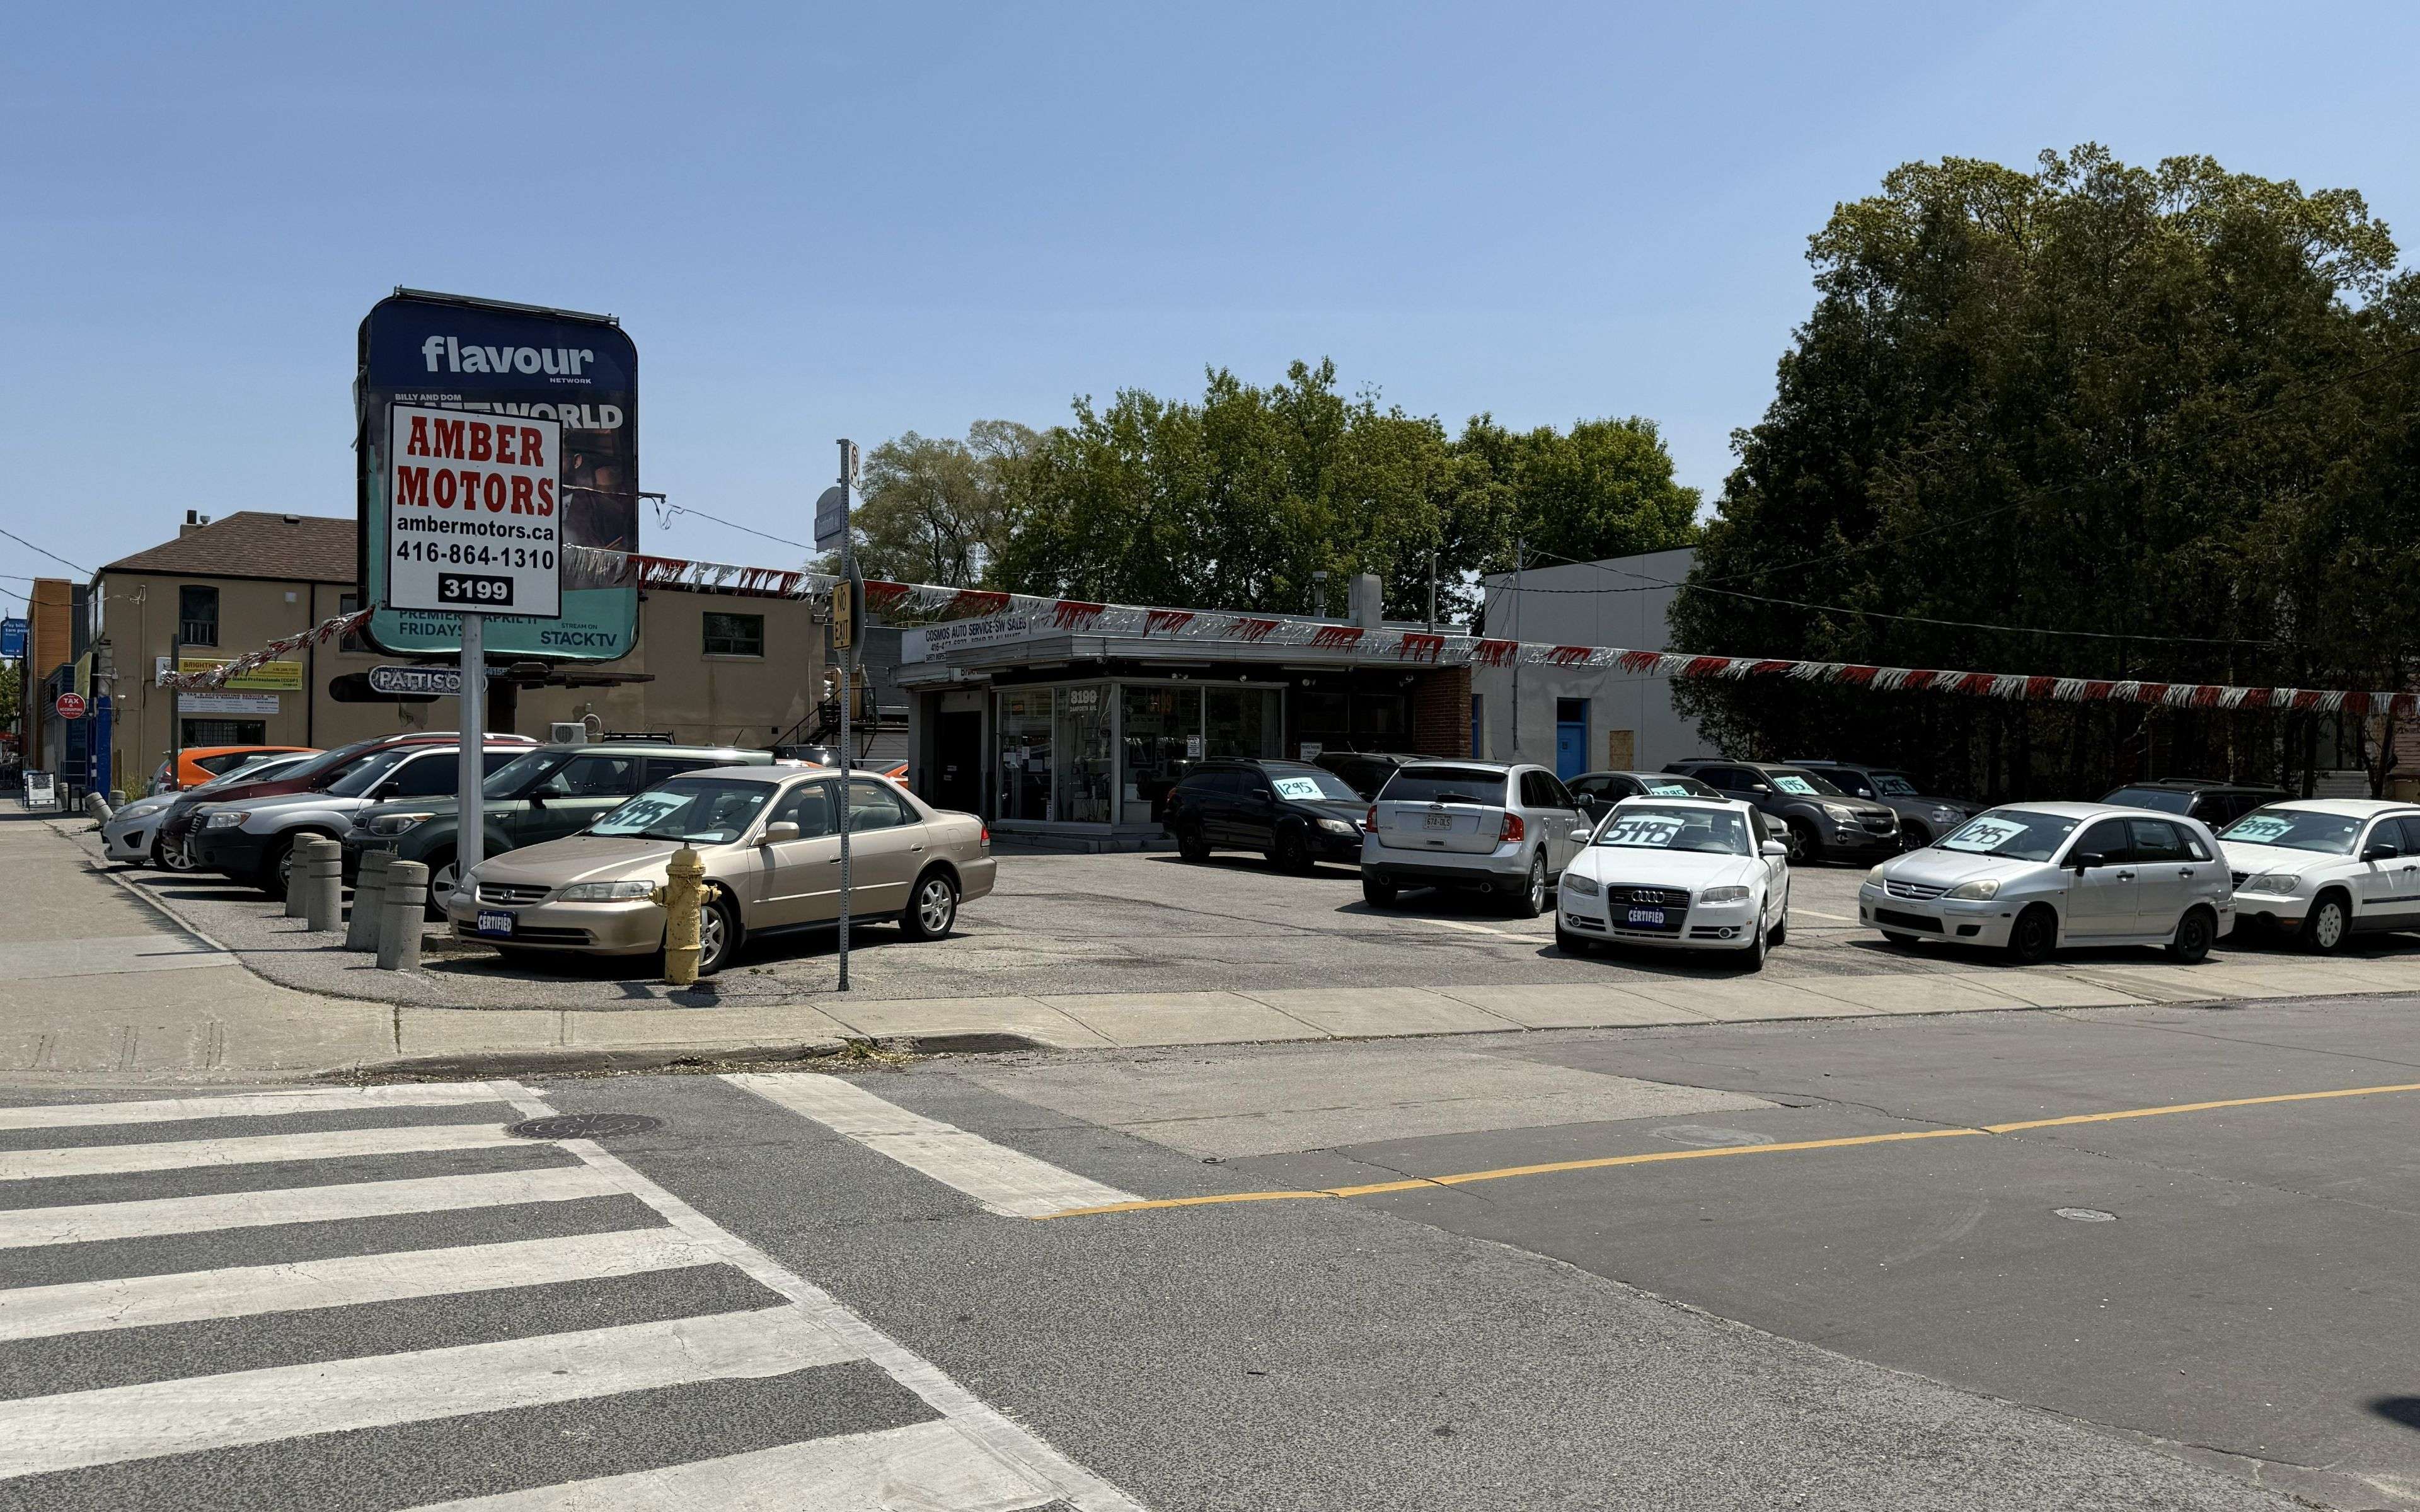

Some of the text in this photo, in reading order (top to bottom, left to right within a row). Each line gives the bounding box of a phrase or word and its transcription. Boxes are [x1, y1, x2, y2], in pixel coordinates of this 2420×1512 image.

[422, 336, 594, 374] flavour
[407, 416, 544, 467] AMBER
[397, 466, 553, 517] MOTORS
[397, 515, 553, 541] ambermotors.ca
[397, 541, 554, 570] 416-864-1310
[444, 579, 507, 599] 3199
[838, 592, 846, 612] NO
[541, 631, 617, 646] STACKTV
[836, 619, 848, 641] EXIT
[926, 628, 950, 642] COSMOS
[952, 624, 967, 639] AUTO
[1601, 821, 1681, 844] 5495
[478, 915, 512, 932] CERTIFIED
[1628, 910, 1664, 924] CERTIFIED
